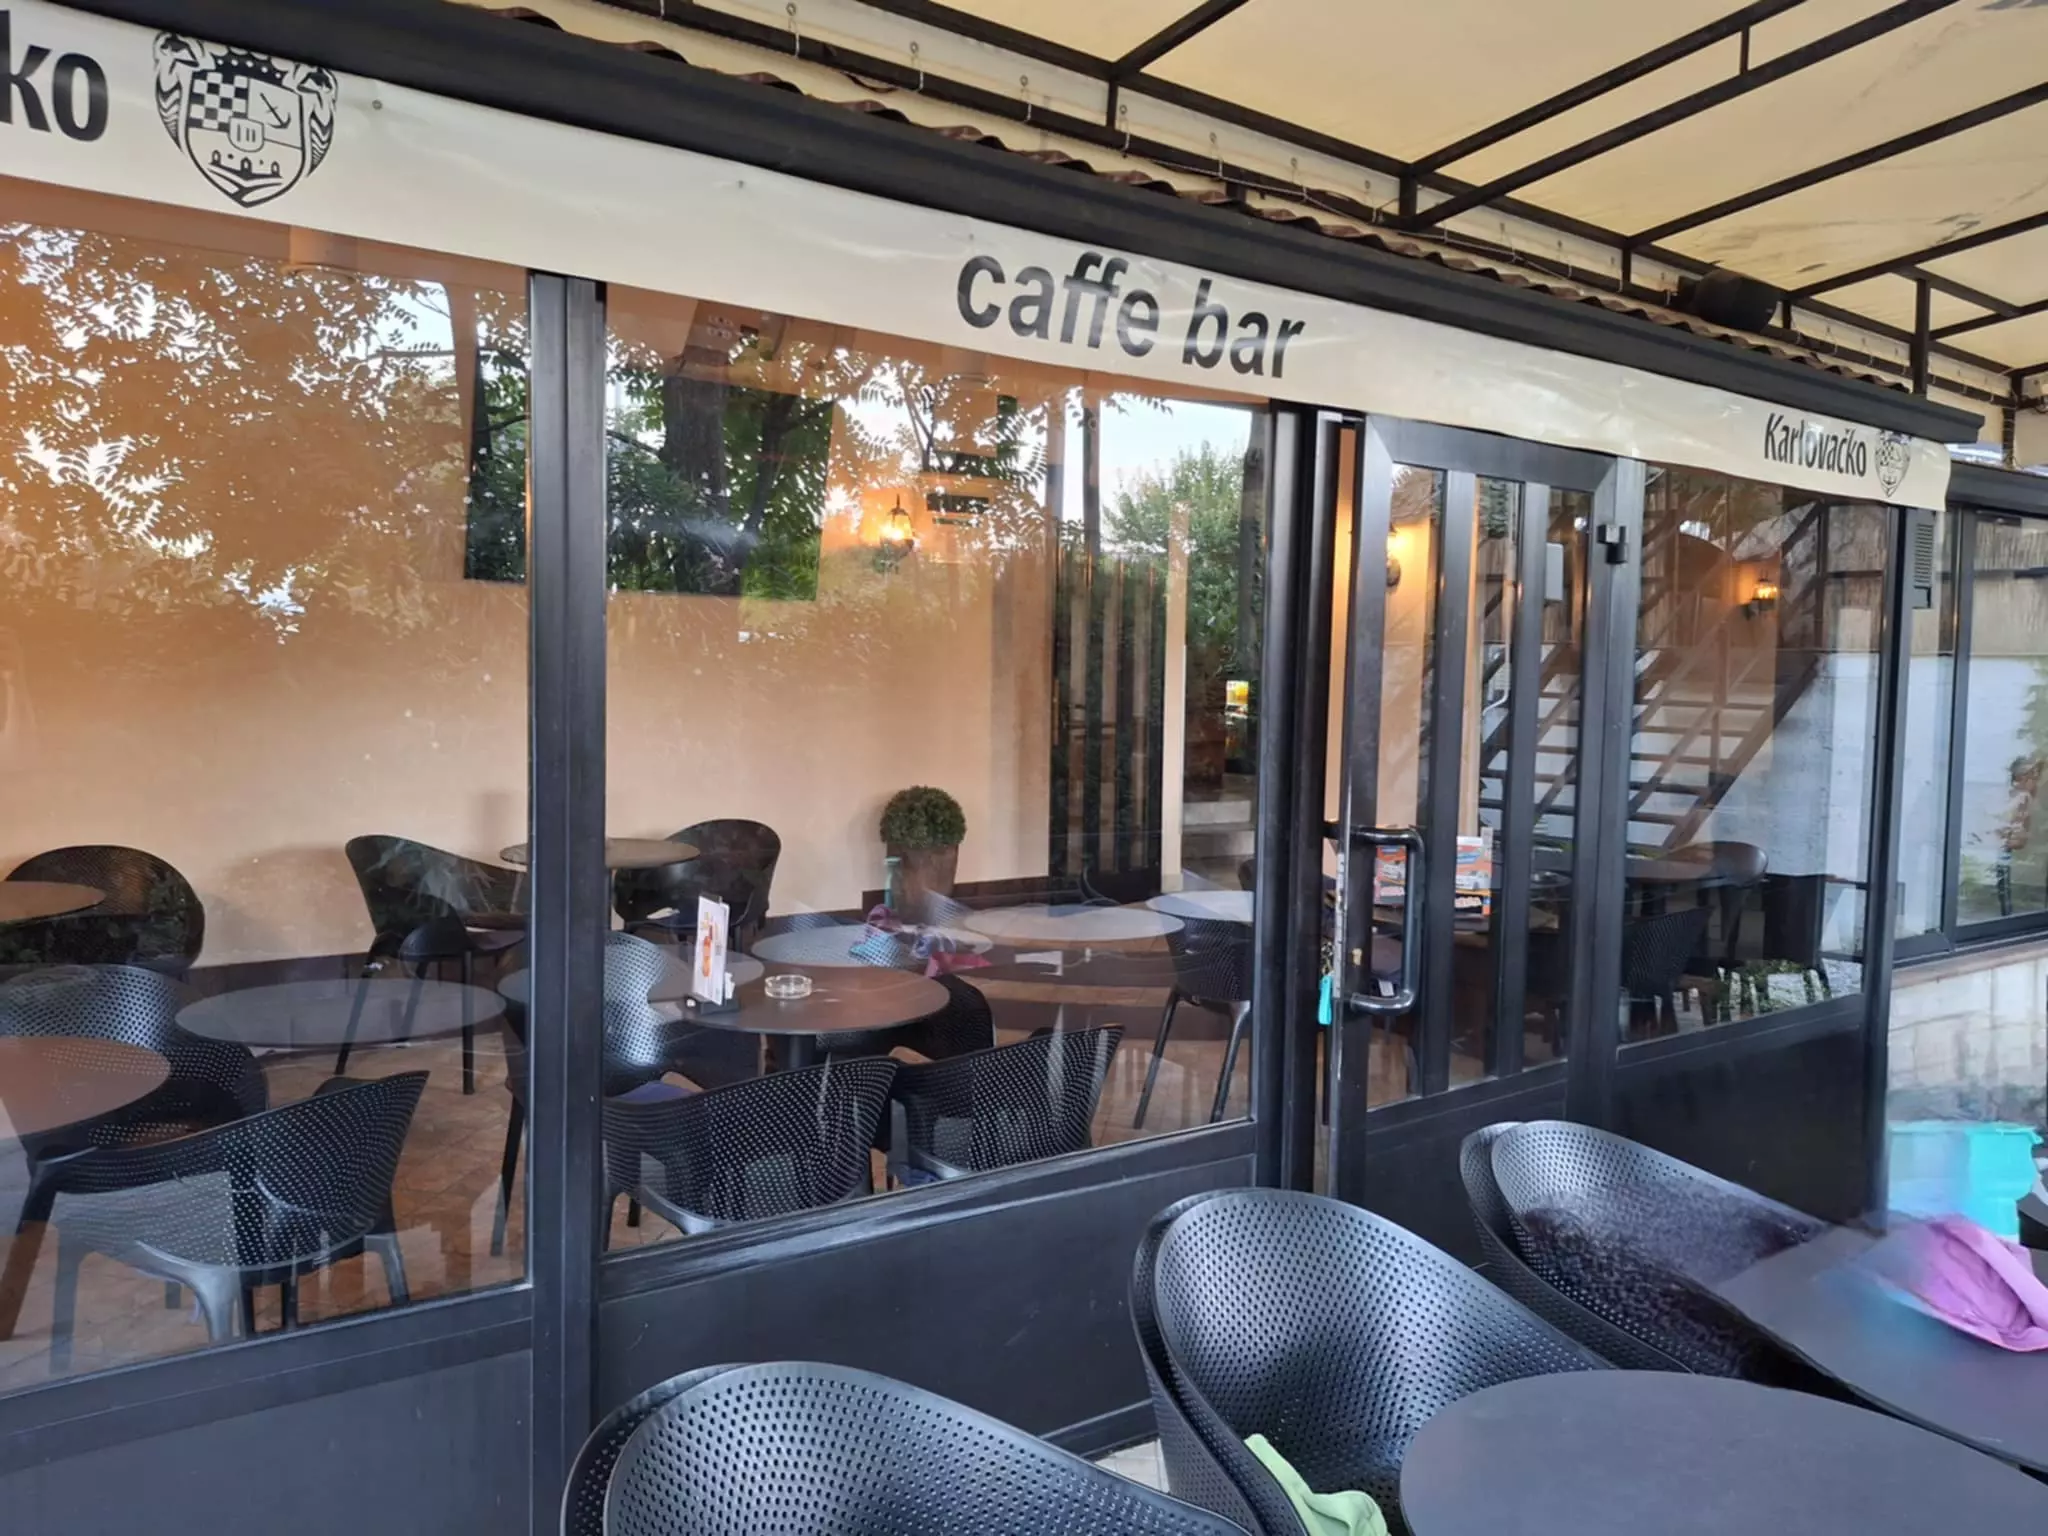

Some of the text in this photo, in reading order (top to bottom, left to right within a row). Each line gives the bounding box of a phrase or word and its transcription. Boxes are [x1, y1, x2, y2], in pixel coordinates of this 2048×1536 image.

[957, 251, 1306, 378] caffe bar
[1764, 412, 1867, 477] Karlovačko
